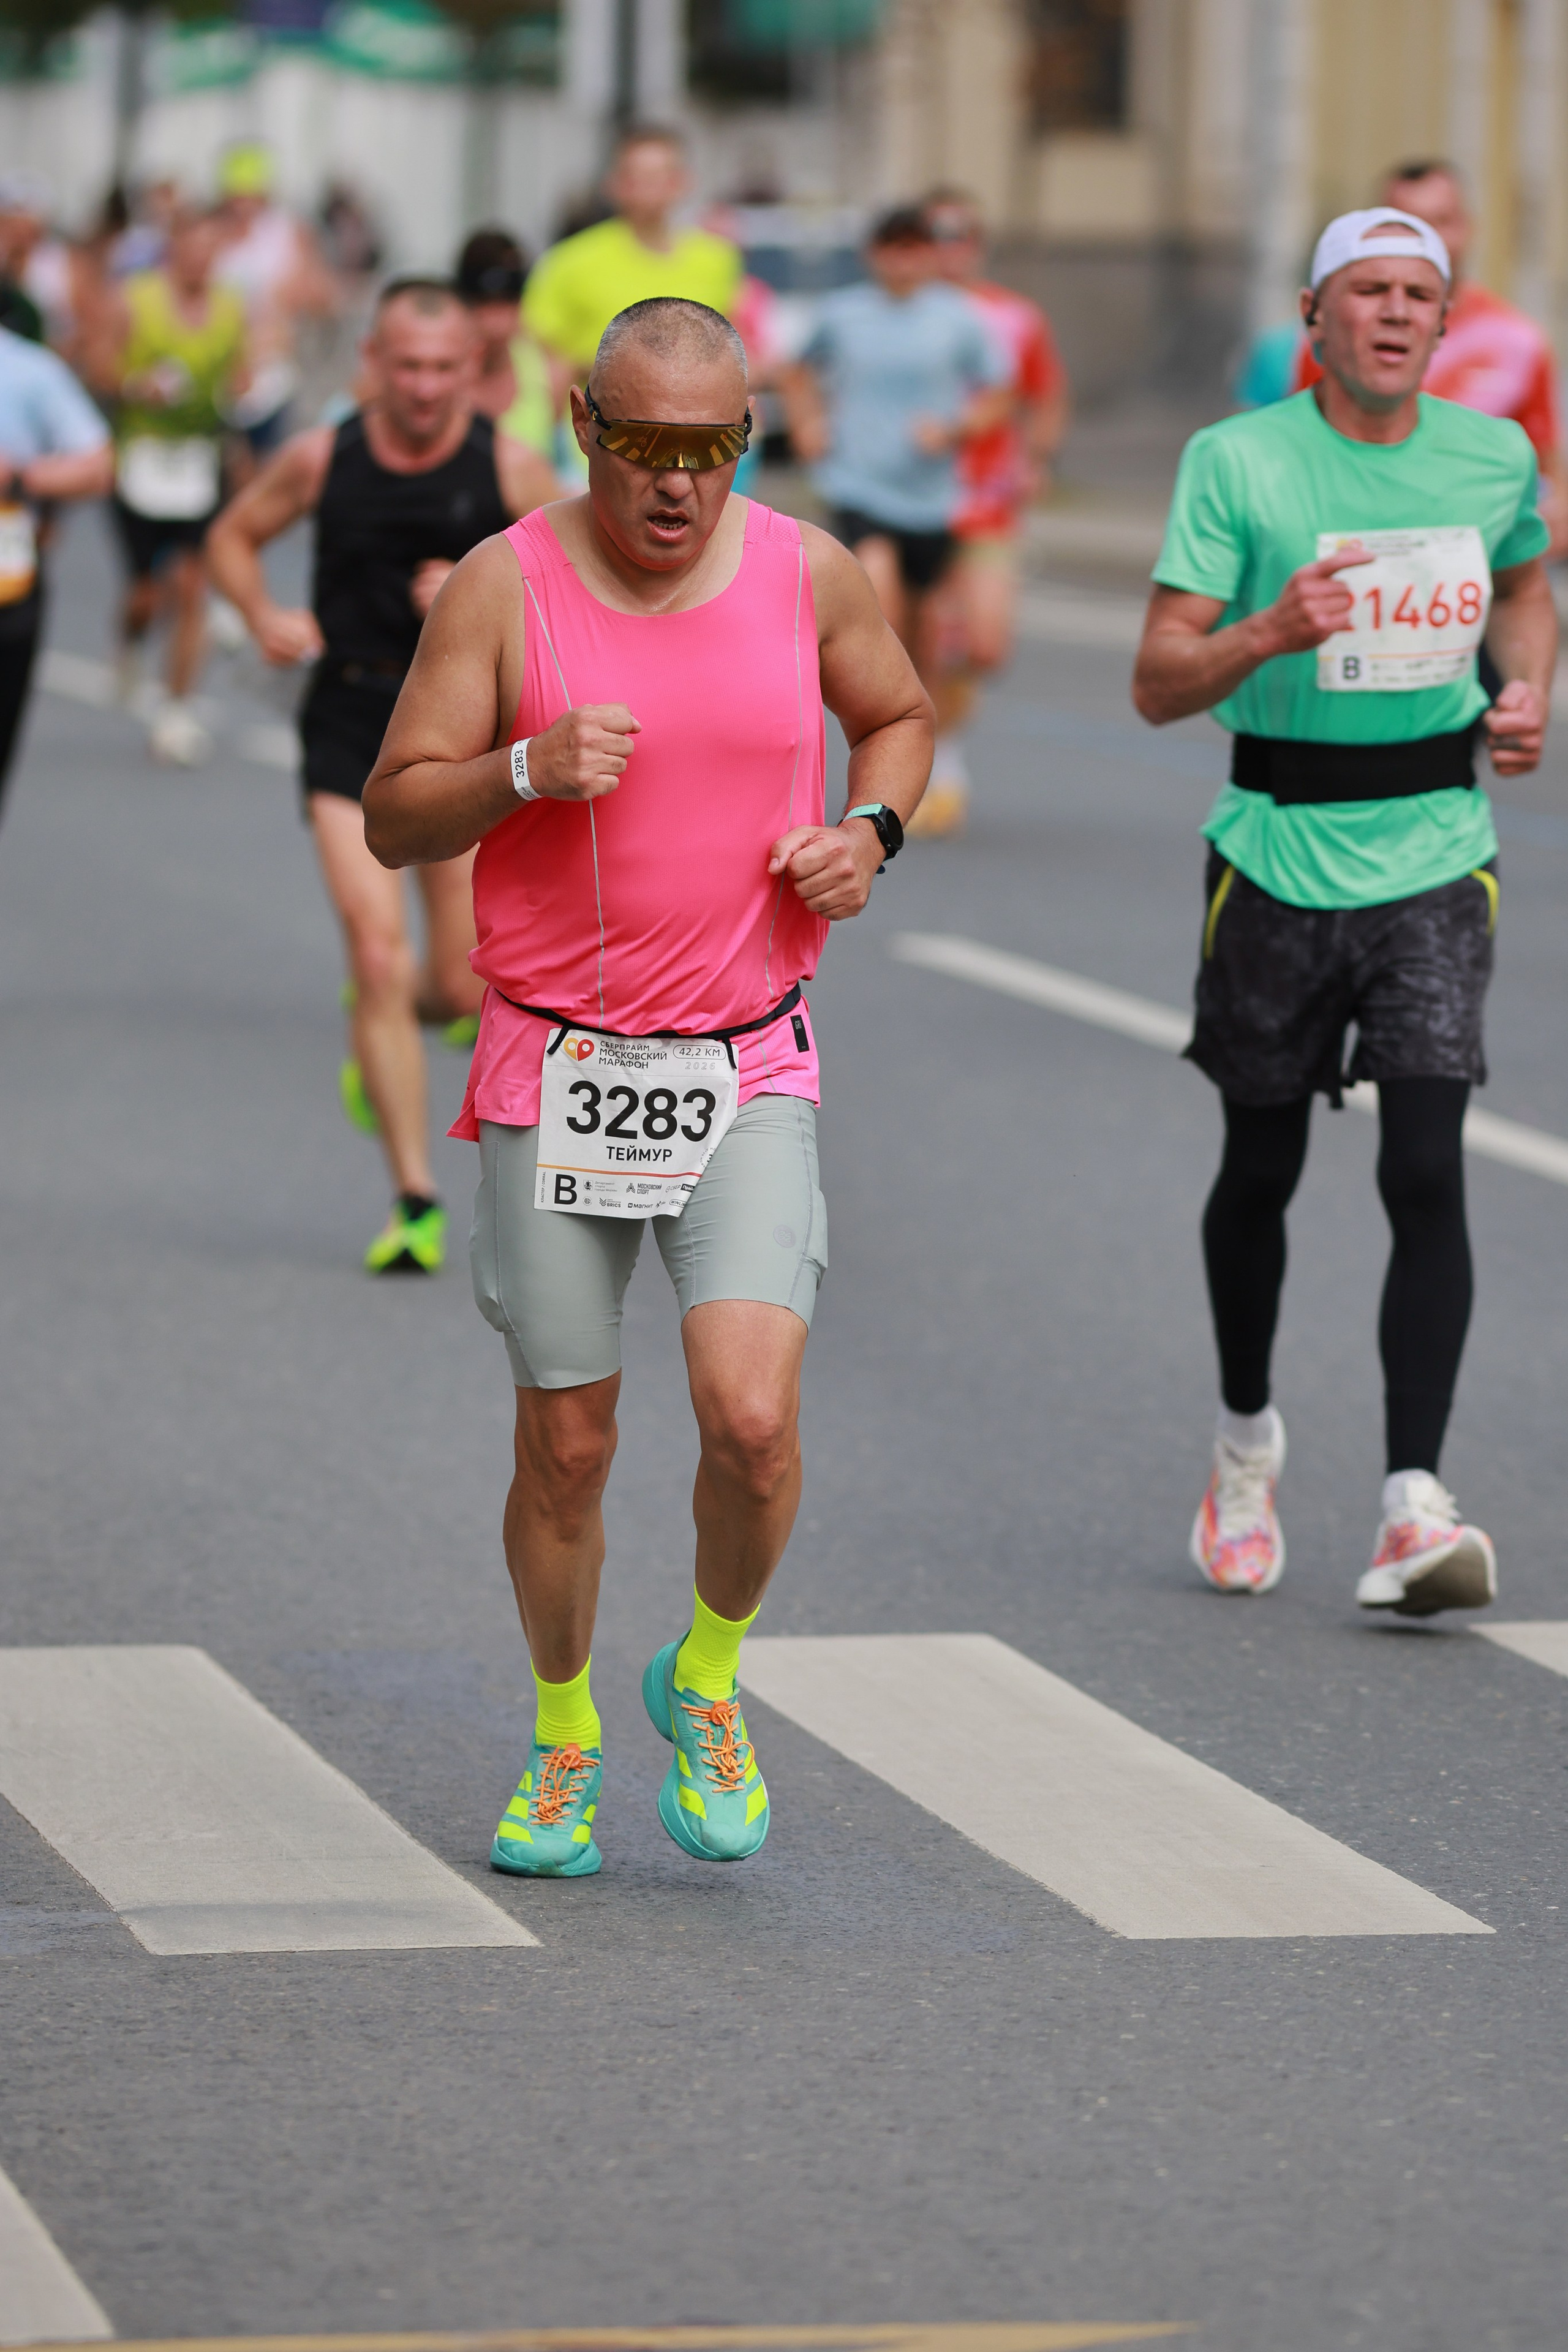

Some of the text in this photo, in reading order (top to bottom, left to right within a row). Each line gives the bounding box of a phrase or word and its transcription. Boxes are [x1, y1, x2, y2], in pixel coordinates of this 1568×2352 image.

[1348, 580, 1481, 631] 1468
[1343, 655, 1360, 680] B
[514, 750, 525, 778] 3283
[599, 1048, 667, 1060] МОСКОВСКИЙ
[600, 1041, 650, 1051] СБЕРПРАЙМ
[679, 1047, 701, 1057] 42,2
[598, 1057, 649, 1069] МАРАФОН
[685, 1061, 715, 1070] 2026
[566, 1080, 717, 1142] 3283
[606, 1145, 673, 1163] ТЕЙМУР
[554, 1173, 578, 1205] B
